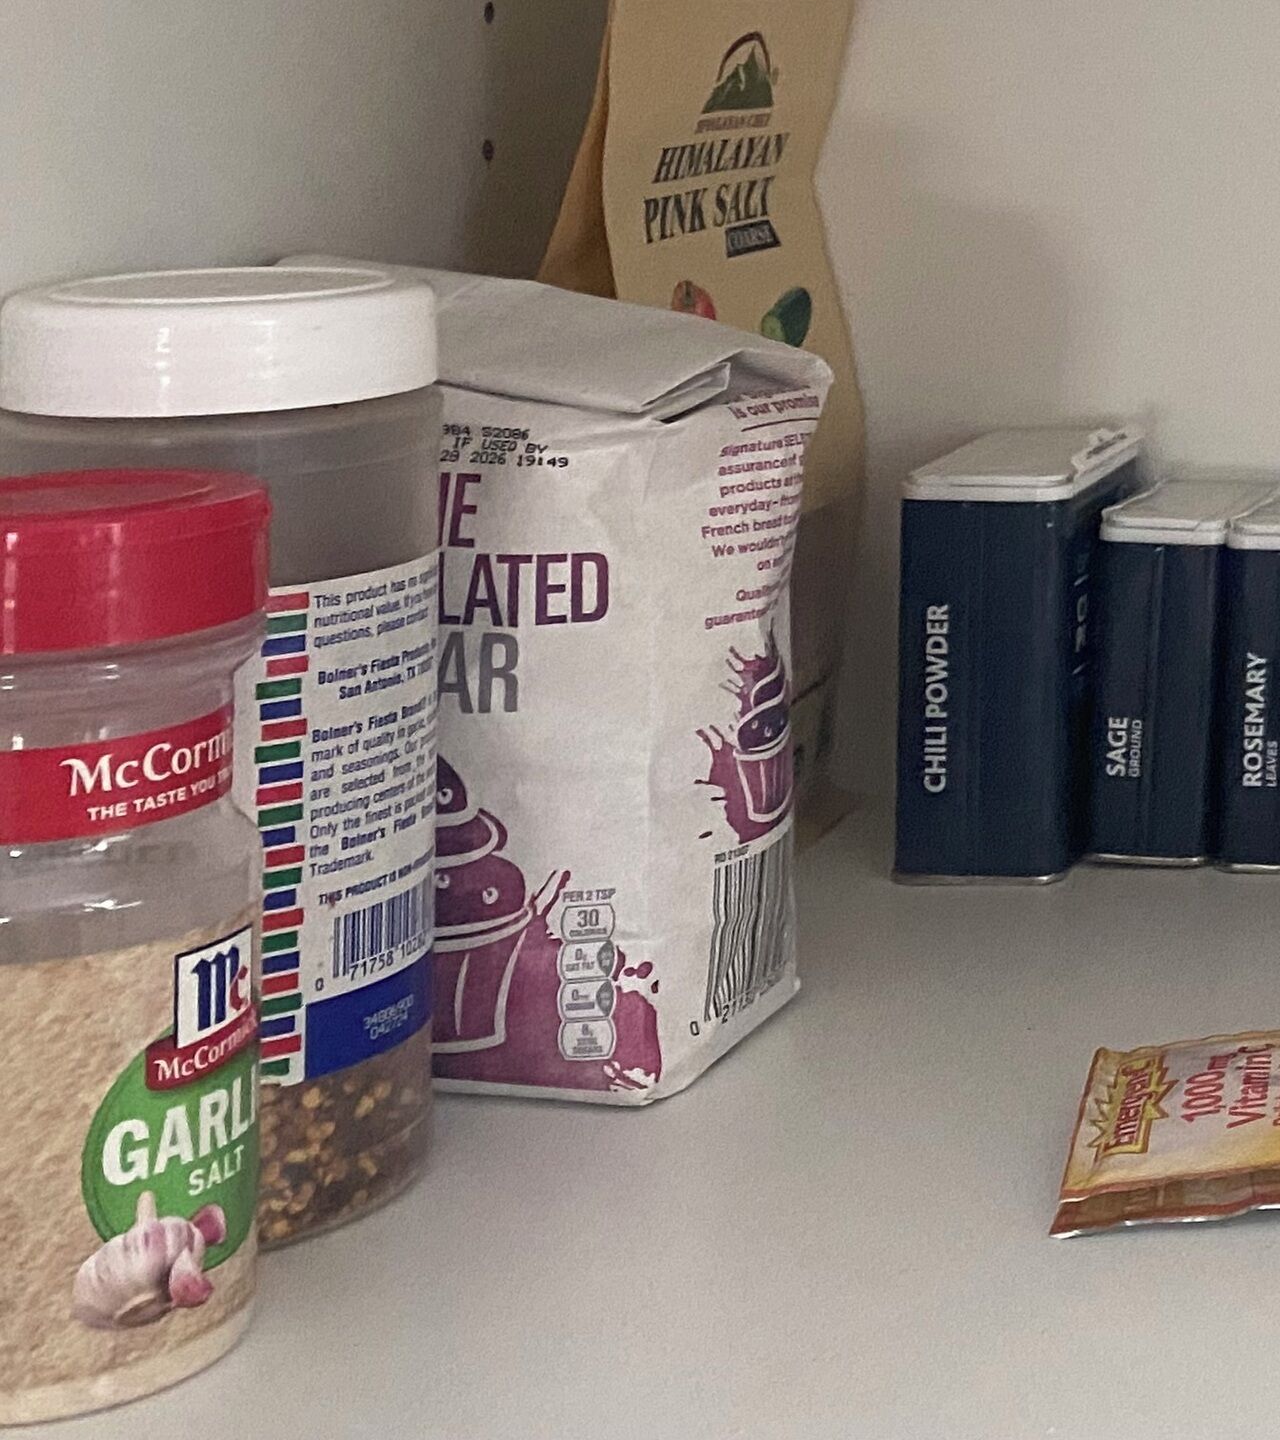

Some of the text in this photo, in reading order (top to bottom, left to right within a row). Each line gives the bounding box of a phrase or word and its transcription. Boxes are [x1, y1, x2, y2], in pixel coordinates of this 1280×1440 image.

[652, 133, 790, 183] HIMALAYAN
[643, 175, 776, 244] PINK SALT
[454, 437, 549, 454] IF USED BY
[719, 458, 787, 476] assurance
[720, 477, 782, 498] products
[702, 521, 749, 539] French
[712, 544, 735, 557] We
[314, 594, 341, 609] This
[346, 584, 387, 605] product
[314, 605, 374, 628] nutritional
[377, 617, 405, 637] please
[318, 663, 368, 685] Bolner's
[370, 656, 400, 674] Fiesta
[339, 685, 362, 700] San
[406, 667, 416, 681] TX
[437, 631, 519, 715] AR
[924, 603, 949, 794] CHILI POWDER
[312, 720, 363, 744] Bolner's
[368, 711, 398, 731] Fiesta
[1242, 652, 1268, 788] ROSEMARY
[311, 731, 395, 762] mark of quality
[1106, 716, 1128, 778] SAGE
[1128, 719, 1143, 779] GROUND
[311, 764, 334, 782] and
[1266, 740, 1279, 788] LEAVES
[87, 802, 128, 821] THE
[133, 787, 187, 813] TASTE
[190, 774, 216, 796] YOU
[310, 770, 385, 802] are selected
[310, 795, 371, 823] producing
[310, 823, 337, 841] Only
[342, 815, 361, 832] the
[365, 806, 393, 825] finest
[309, 843, 330, 858] the
[341, 827, 386, 851] Bolner's
[310, 850, 375, 878] Trademark.
[319, 888, 343, 905] THIS
[345, 873, 388, 899] PRODUCT
[562, 888, 616, 903] PER 2 TSP
[577, 908, 600, 928] 30
[350, 951, 394, 981] 71758
[1226, 1052, 1273, 1129] Vitamin
[188, 1143, 245, 1197] SALT
